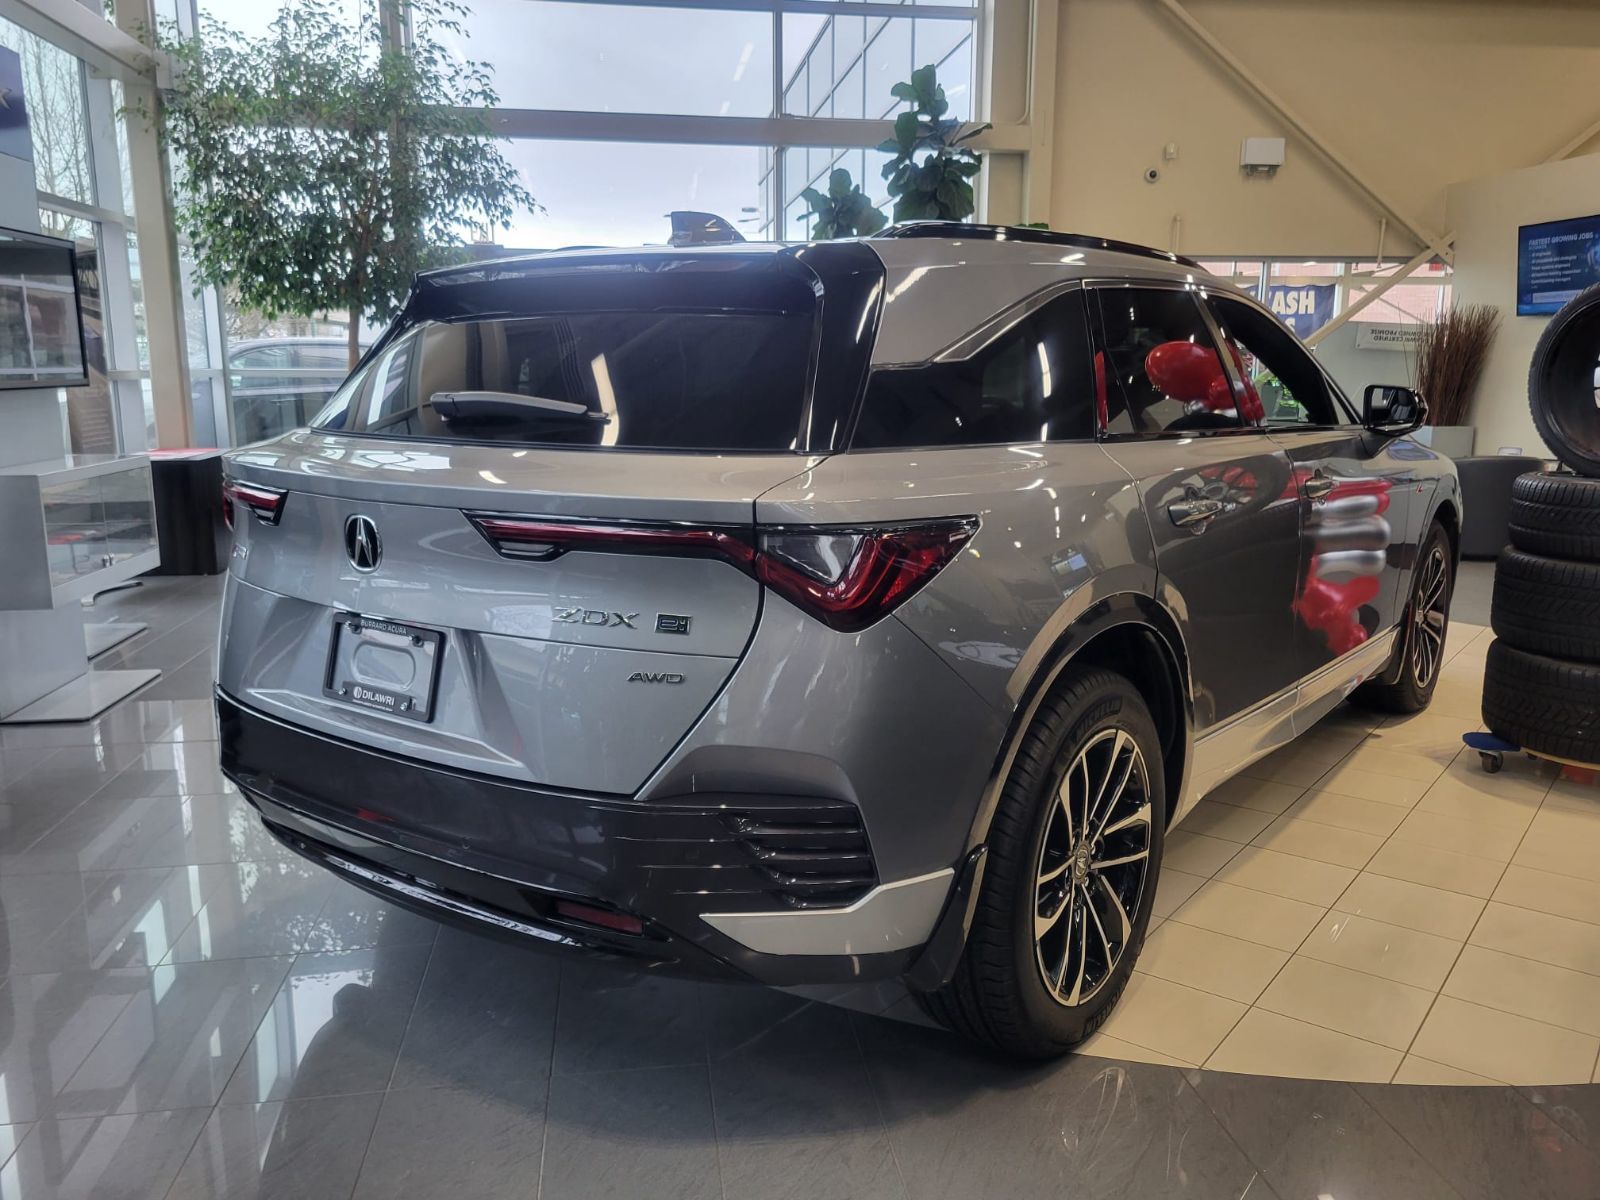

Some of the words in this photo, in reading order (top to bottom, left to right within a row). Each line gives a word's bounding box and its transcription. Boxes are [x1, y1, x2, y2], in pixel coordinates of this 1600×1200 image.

[1268, 290, 1315, 315] ASH
[551, 606, 640, 629] ZDX
[387, 625, 407, 635] ACURA
[627, 671, 684, 684] AWD
[362, 690, 395, 706] DILAWRI
